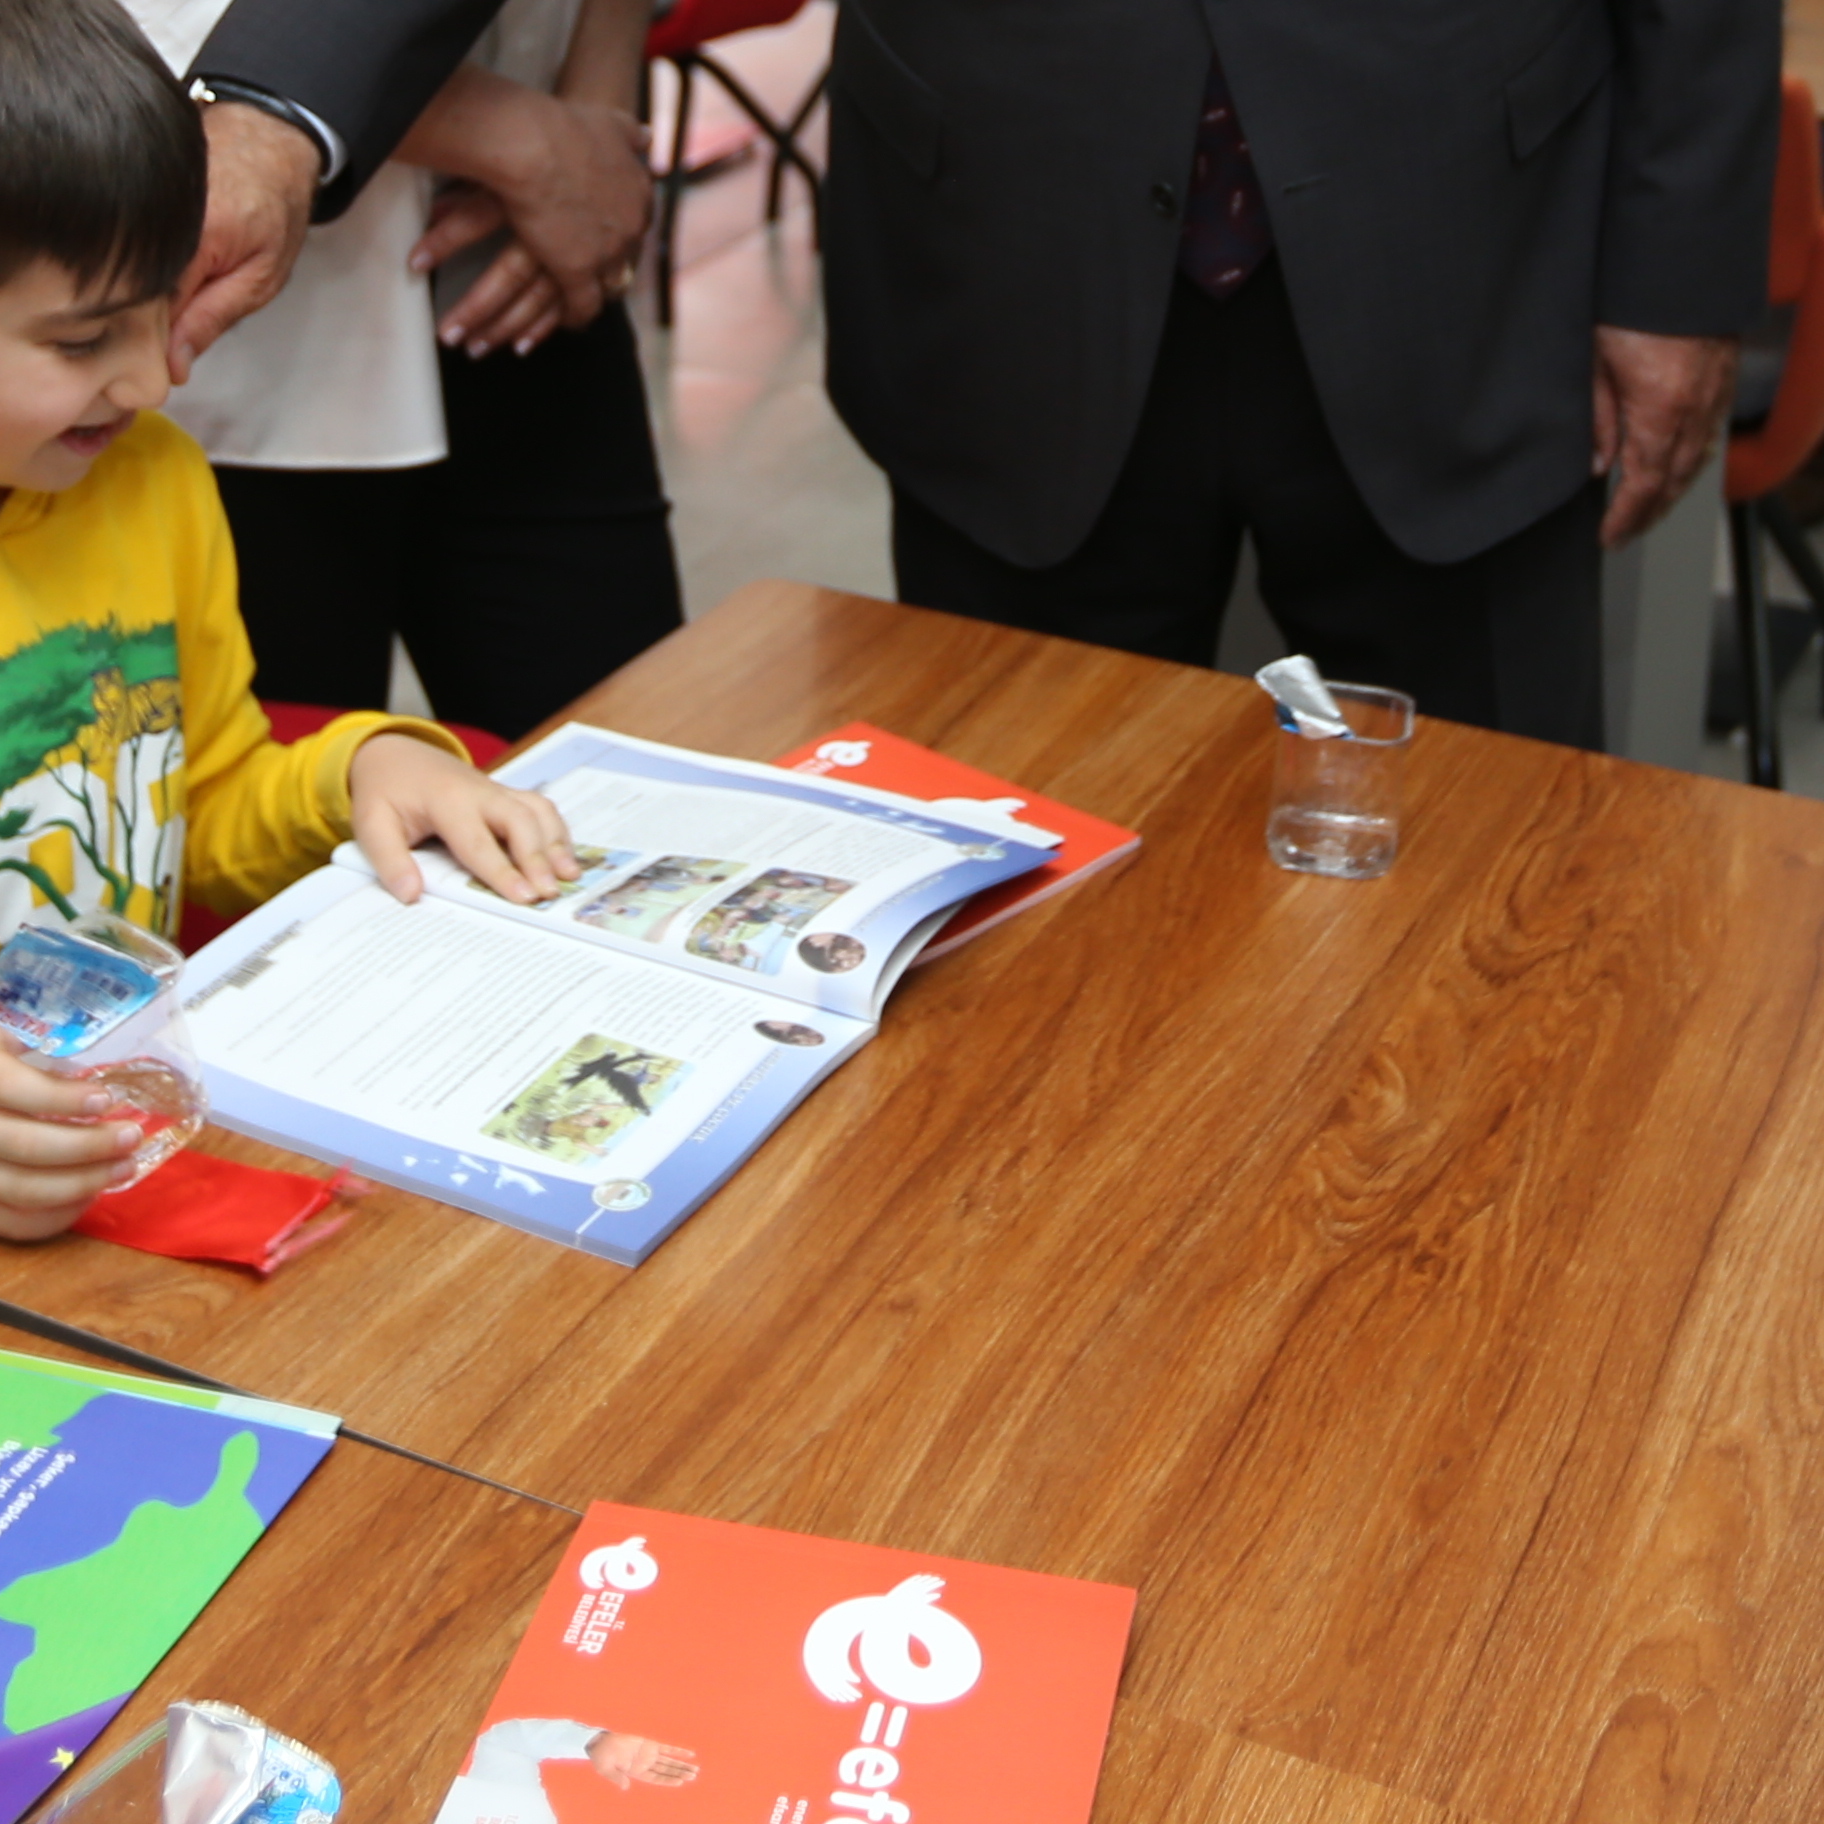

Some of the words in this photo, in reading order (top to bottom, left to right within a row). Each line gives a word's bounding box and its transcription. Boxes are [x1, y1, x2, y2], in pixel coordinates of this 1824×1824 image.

[10, 1446, 48, 1477] Uzay
[562, 1593, 597, 1645] BELEDİYESİ
[576, 1590, 626, 1654] EFELER
